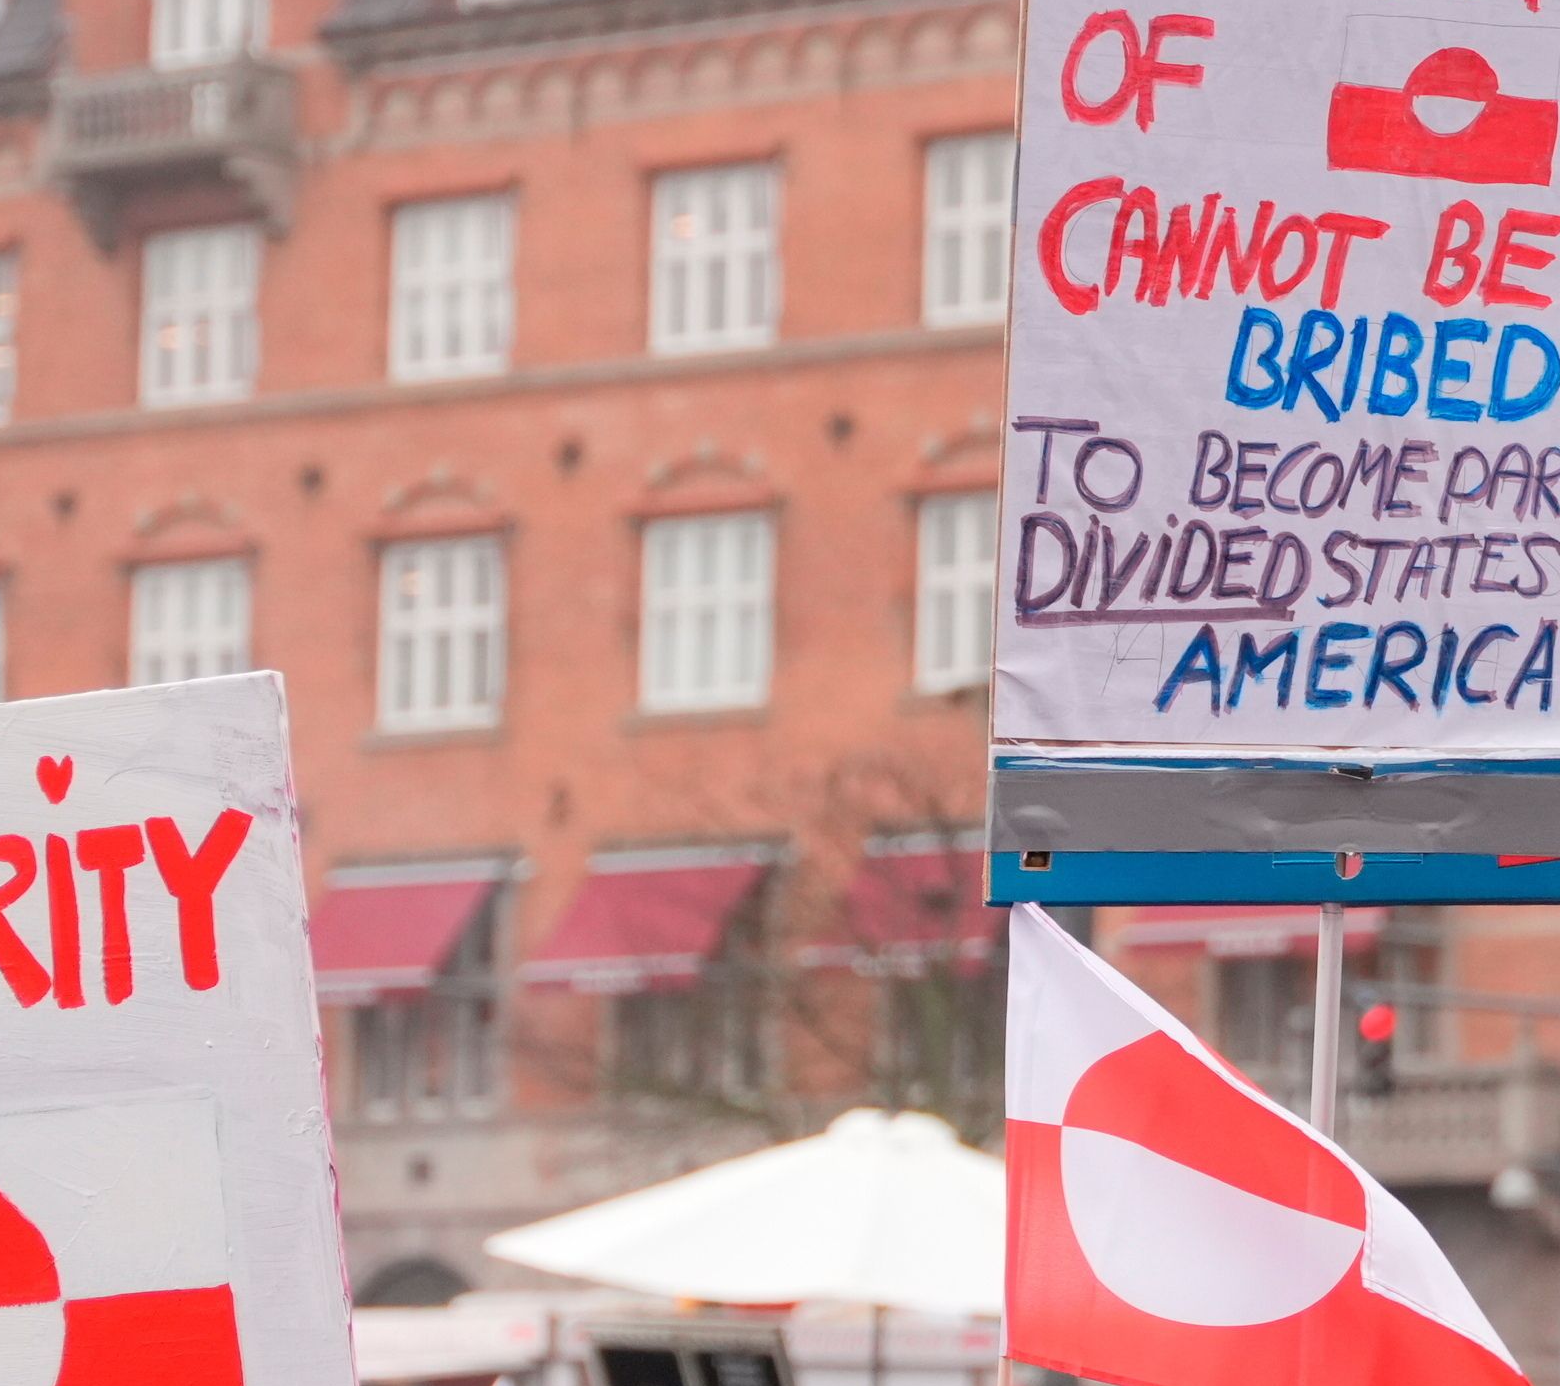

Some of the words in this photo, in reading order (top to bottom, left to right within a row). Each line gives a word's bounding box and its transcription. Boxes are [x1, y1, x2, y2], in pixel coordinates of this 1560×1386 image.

[1061, 8, 1215, 132] OF
[1037, 174, 1391, 315] CANNOT
[1013, 416, 1144, 512] TO
[1189, 429, 1438, 519] BECOME
[1153, 618, 1560, 718] AMERICA
